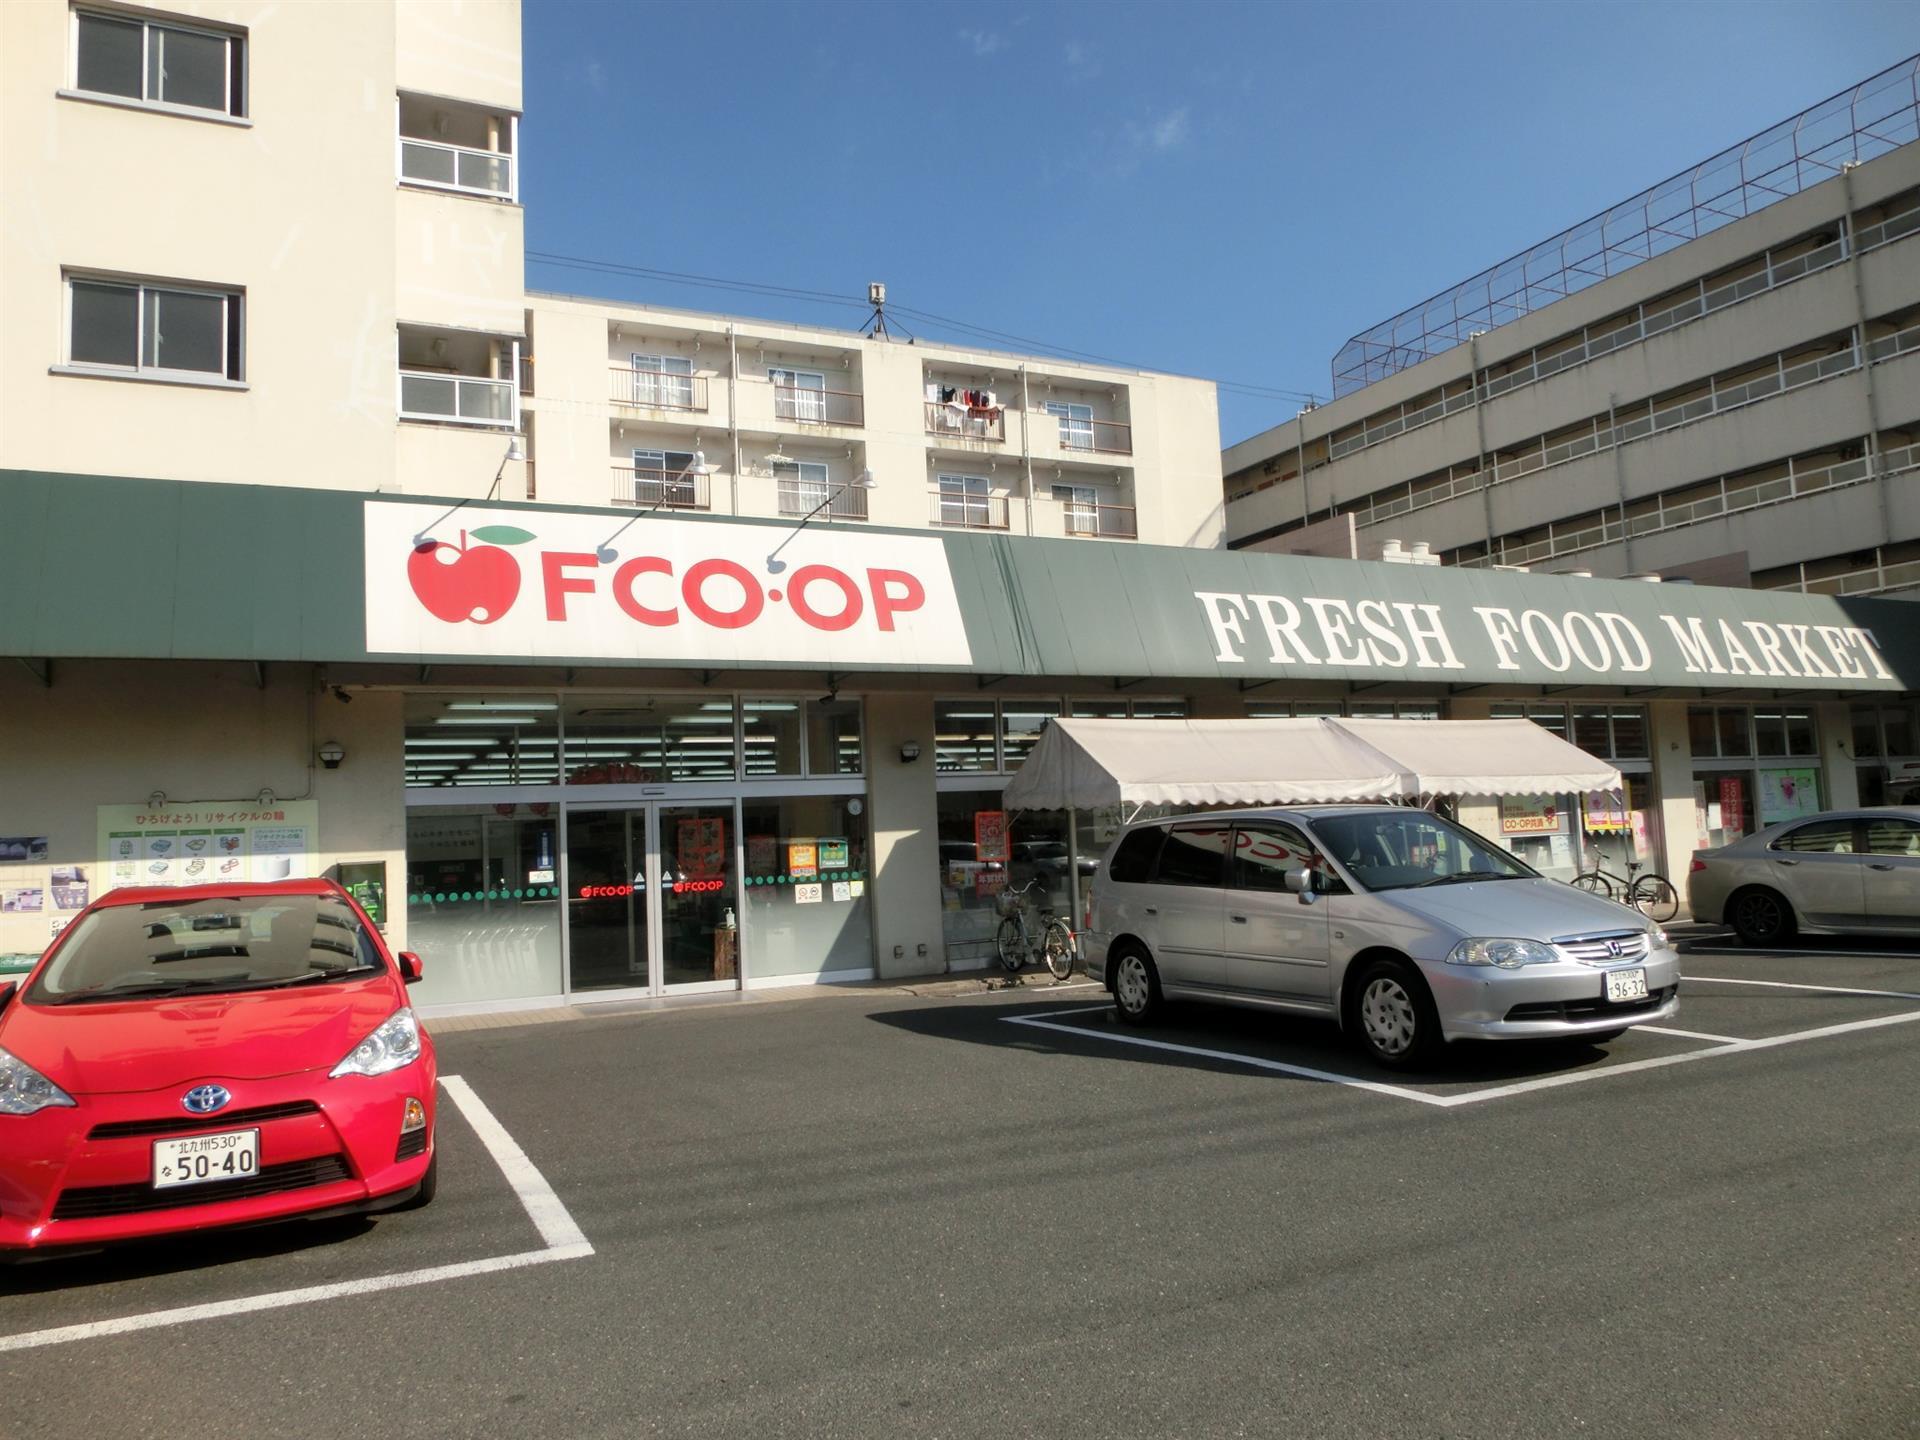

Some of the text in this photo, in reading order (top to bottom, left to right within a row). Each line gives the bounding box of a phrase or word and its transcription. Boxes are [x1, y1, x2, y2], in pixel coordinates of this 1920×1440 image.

[1194, 590, 1893, 680] FRESH FOOD MARKET
[178, 1135, 236, 1154] 北九州530
[178, 1149, 252, 1181] 50-40
